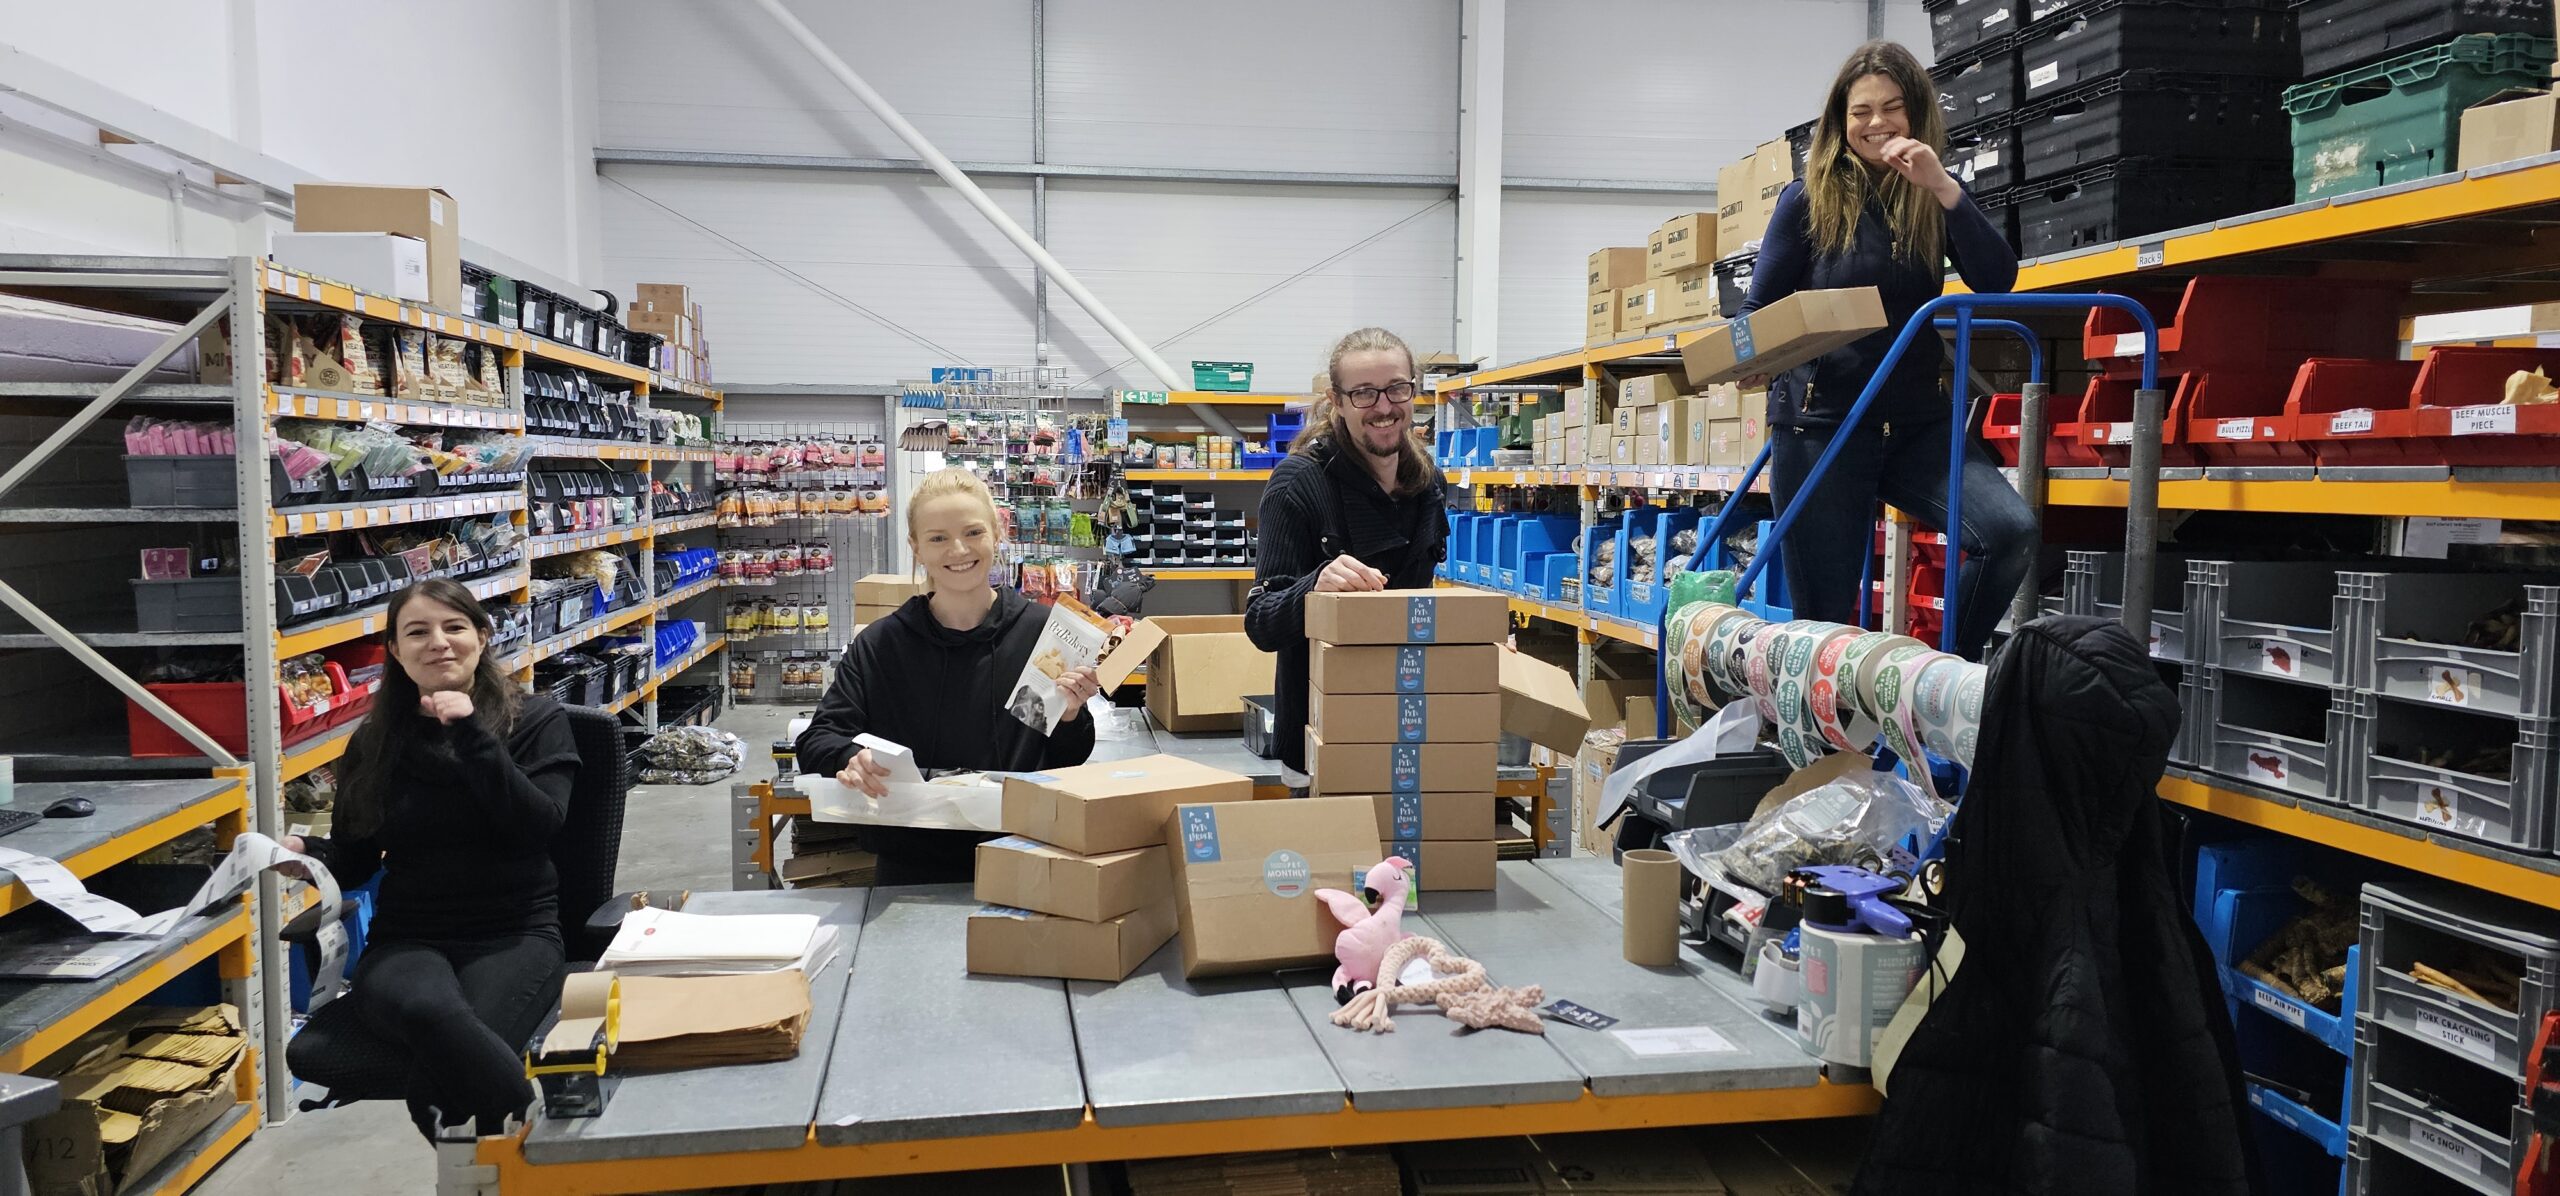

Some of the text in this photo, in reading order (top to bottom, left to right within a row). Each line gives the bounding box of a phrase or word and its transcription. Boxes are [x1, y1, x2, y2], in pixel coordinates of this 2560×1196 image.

[2140, 252, 2162, 265] Rack 9
[2456, 406, 2511, 419] BEEF MUSCLE
[2221, 426, 2235, 434] BULL
[2334, 419, 2370, 431] BEEF TAIL
[2471, 420, 2494, 430] PIECE
[1267, 869, 1306, 879] MONTHLY
[2258, 991, 2301, 1017] BEEF AIR PIPE
[2418, 1010, 2491, 1043] PORK CRACKLING
[2442, 1030, 2465, 1045] STICK
[2421, 1130, 2465, 1156] PIG SNOUT
